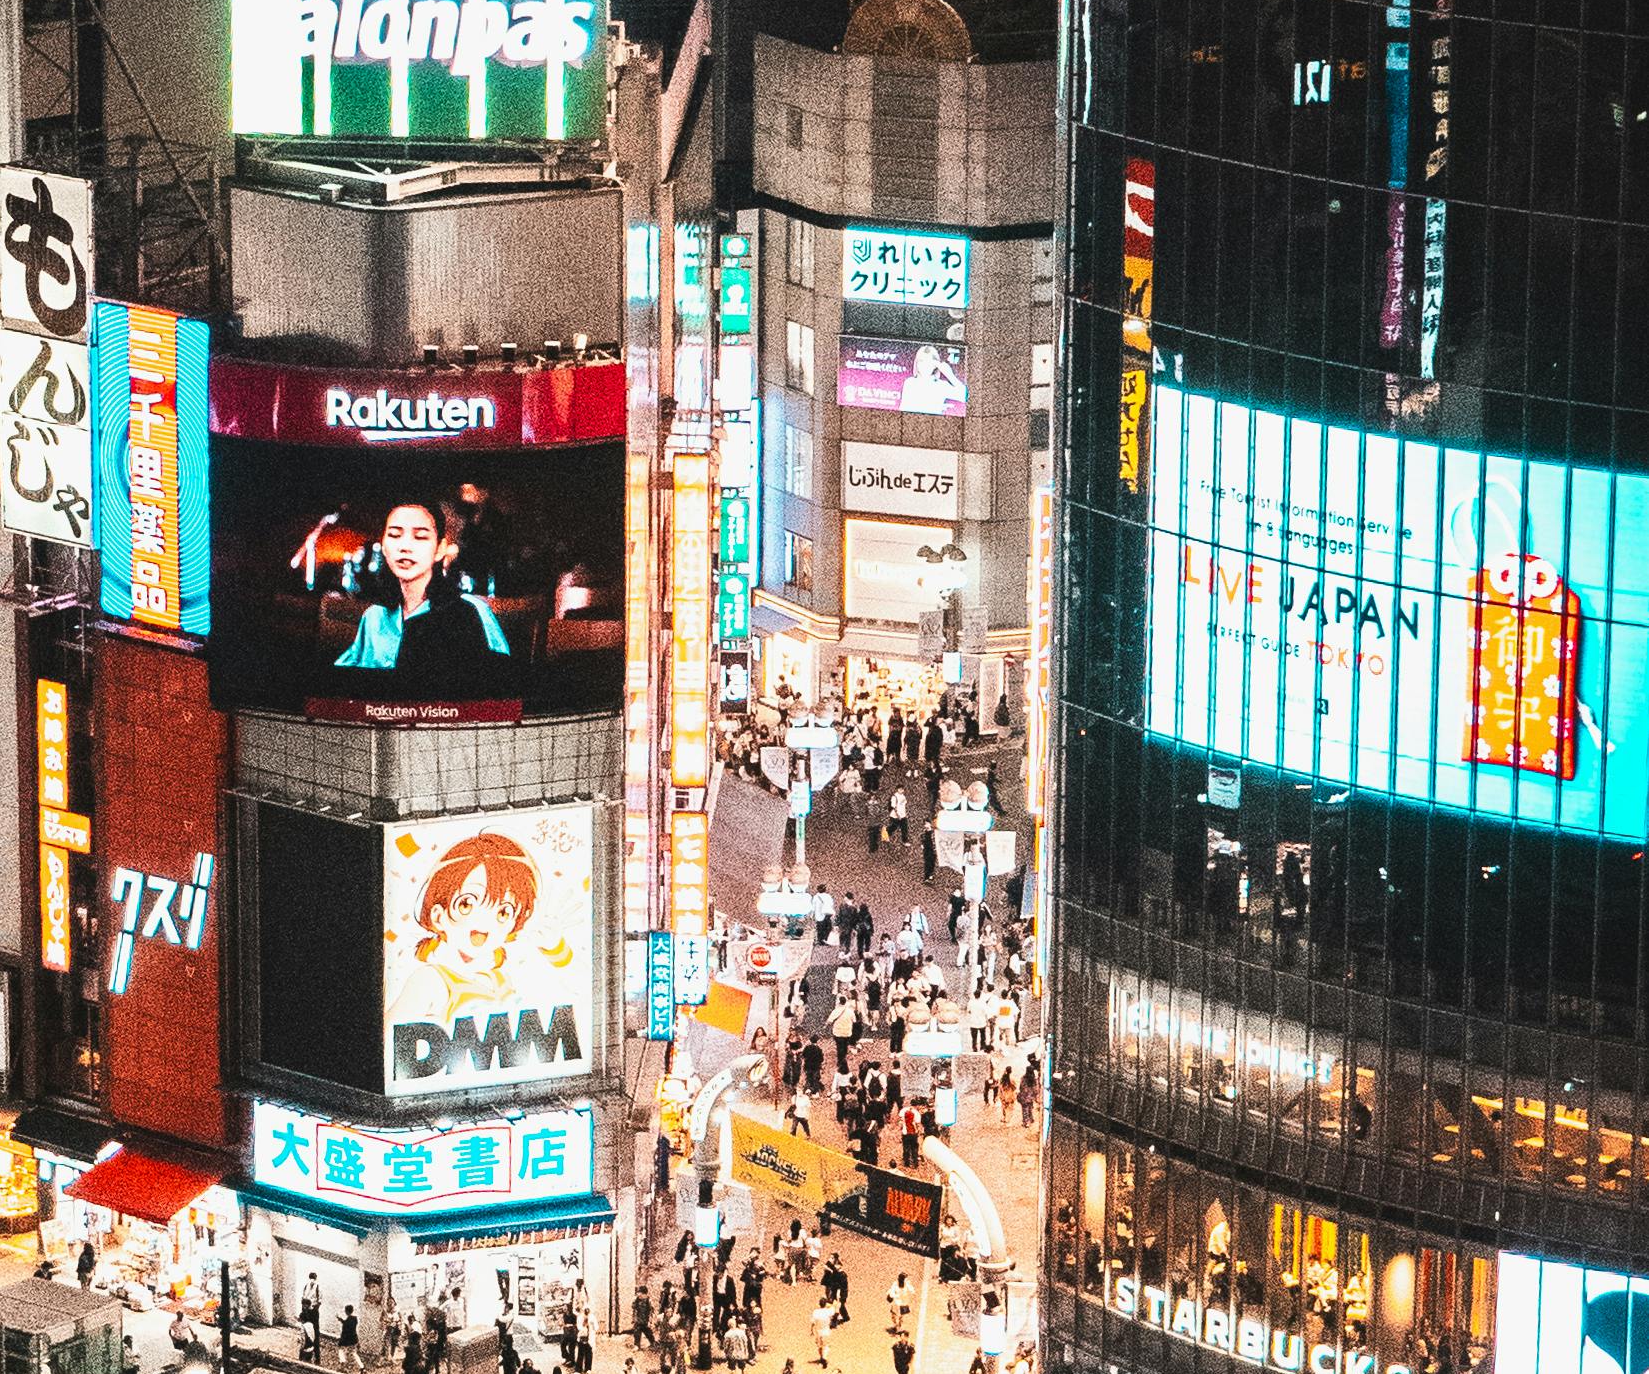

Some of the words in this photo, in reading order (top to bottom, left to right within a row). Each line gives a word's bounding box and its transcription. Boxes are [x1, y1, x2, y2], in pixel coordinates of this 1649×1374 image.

[851, 271, 961, 300] クリニック
[878, 241, 962, 269] れいわ
[4, 176, 90, 538] もんじゃ
[326, 387, 495, 429] Rakuten
[129, 329, 167, 612] 三千里薬品
[1275, 496, 1355, 528] Inormation
[1184, 544, 1263, 605] LIVE
[1279, 576, 1420, 640] JAPAN
[365, 704, 417, 720] Rakuten
[419, 705, 459, 719] Vision
[1492, 614, 1544, 741] 御守
[394, 1004, 583, 1080] DMM
[272, 1123, 568, 1193] 大盛堂書店
